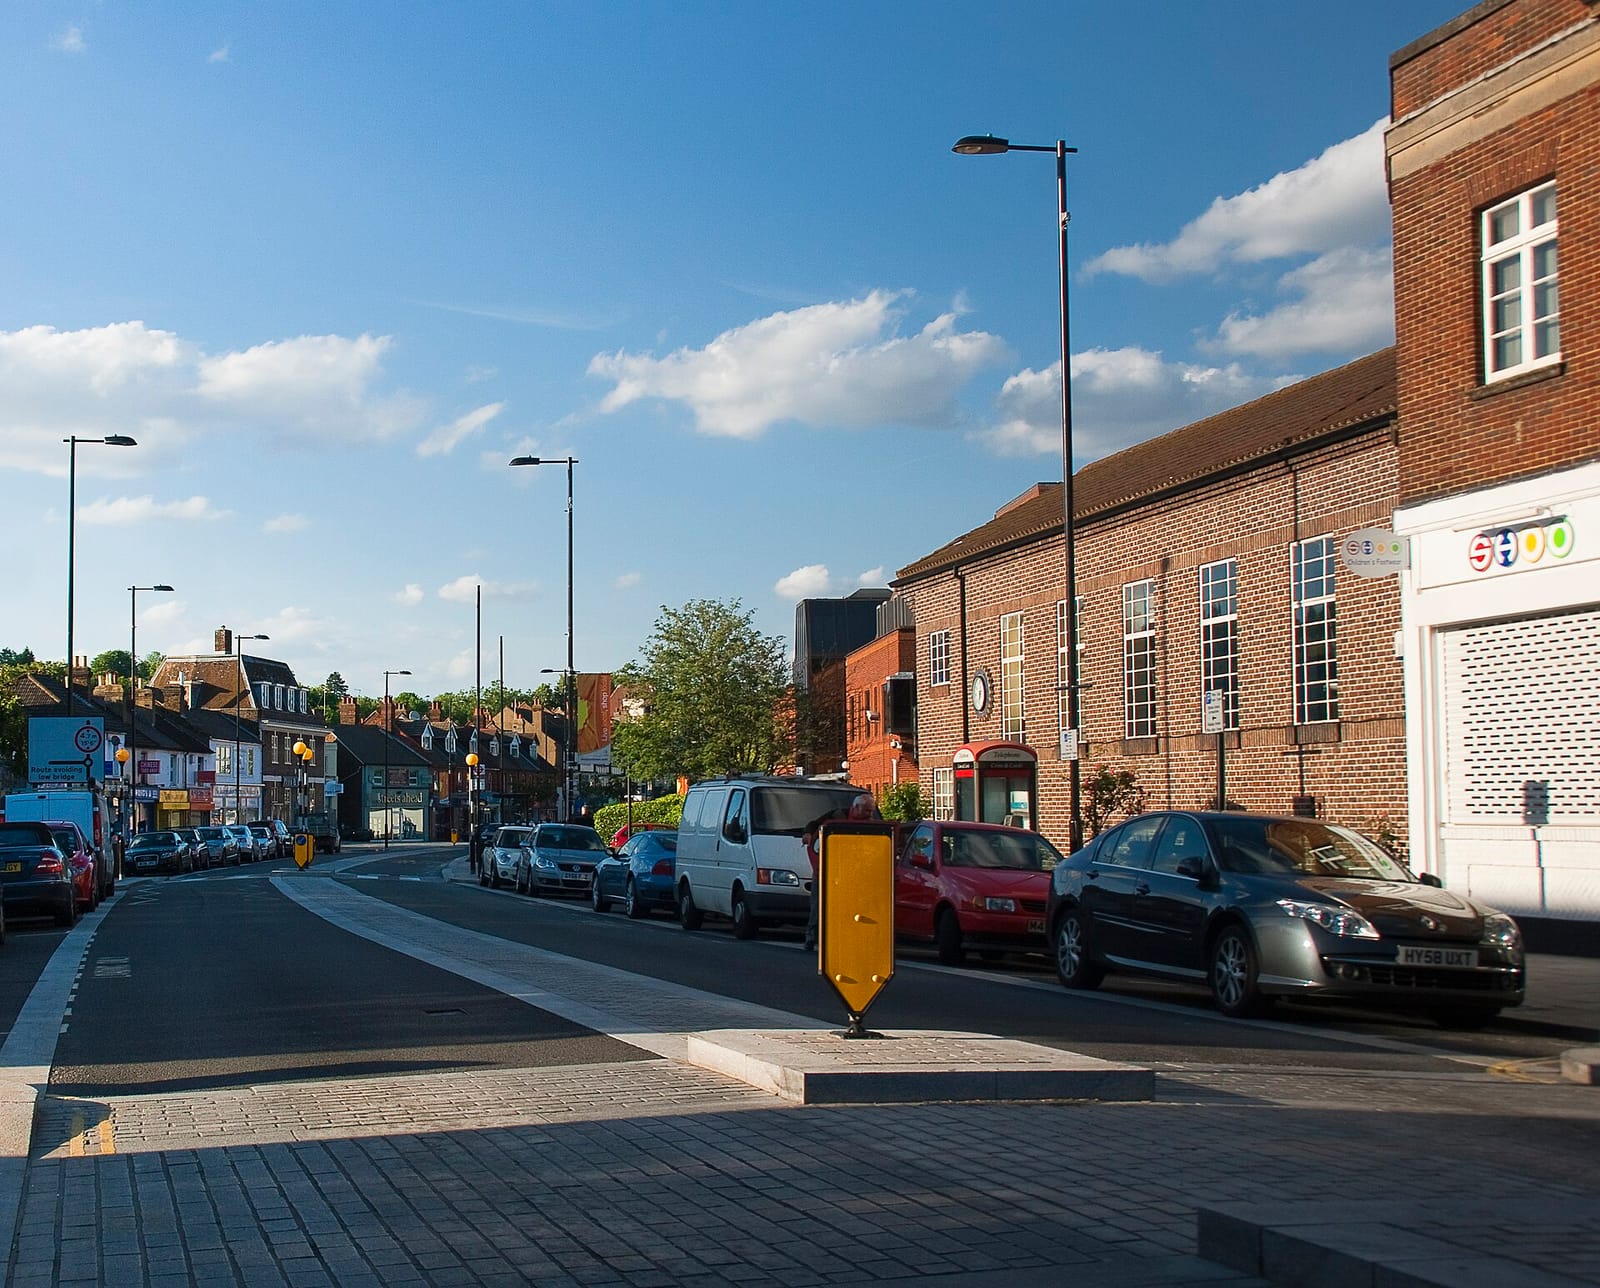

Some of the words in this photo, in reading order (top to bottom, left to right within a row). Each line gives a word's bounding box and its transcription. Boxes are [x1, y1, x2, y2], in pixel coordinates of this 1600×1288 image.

[1347, 558, 1375, 566] Children's
[1376, 558, 1402, 566] Footwear
[53, 766, 83, 774] avoiding
[401, 792, 423, 803] ahead
[1405, 948, 1441, 964] HY58
[1446, 951, 1472, 966] UXT
